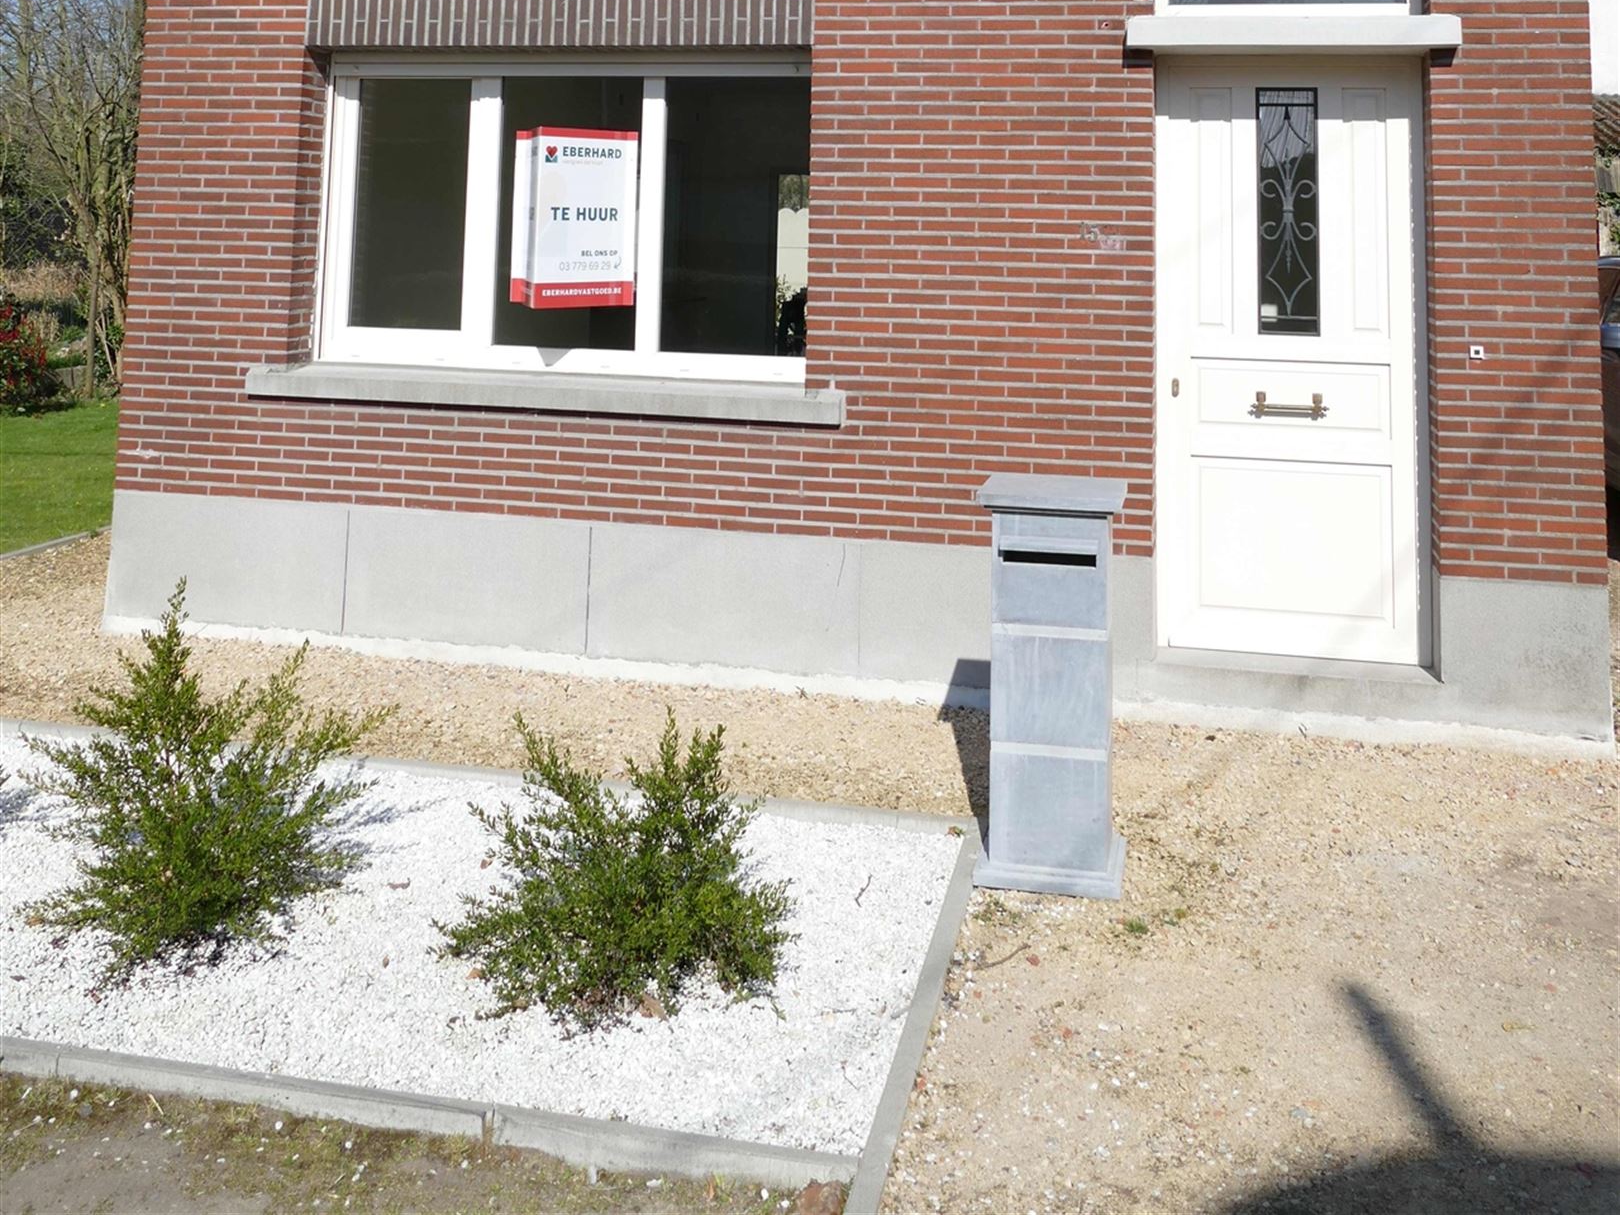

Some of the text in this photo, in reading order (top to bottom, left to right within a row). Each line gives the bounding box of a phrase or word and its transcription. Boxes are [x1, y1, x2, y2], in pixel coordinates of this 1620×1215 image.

[562, 146, 622, 159] EBERHARD
[550, 206, 570, 221] TE
[576, 207, 618, 221] HUUR
